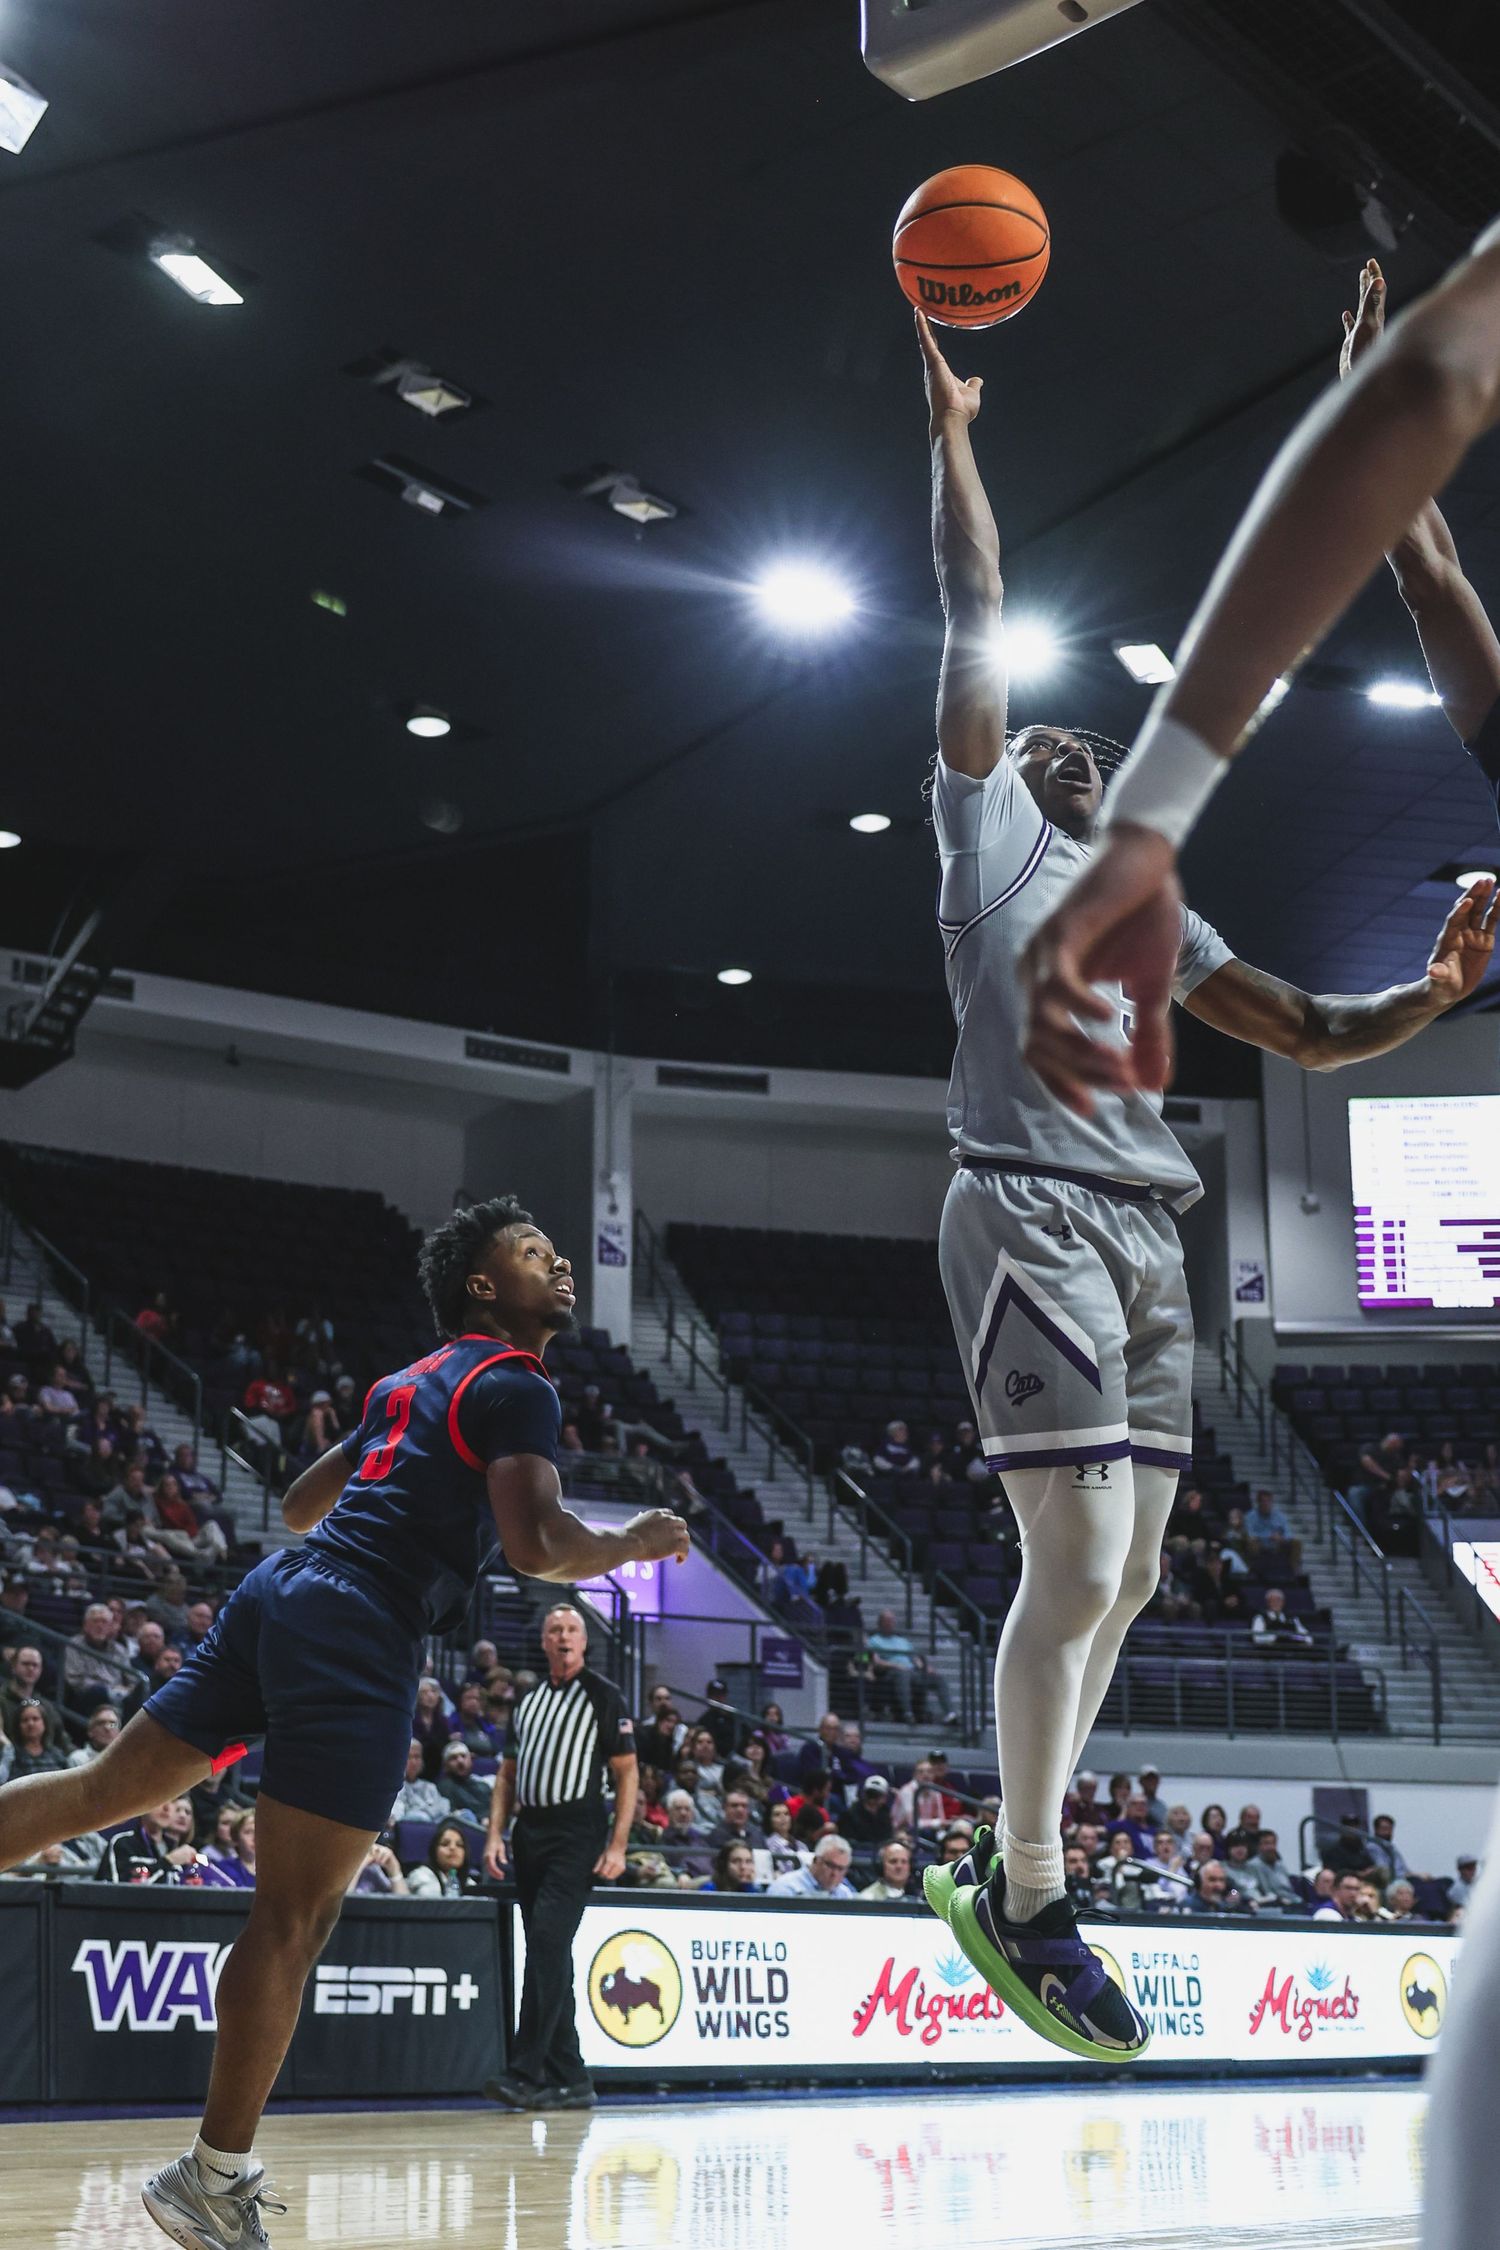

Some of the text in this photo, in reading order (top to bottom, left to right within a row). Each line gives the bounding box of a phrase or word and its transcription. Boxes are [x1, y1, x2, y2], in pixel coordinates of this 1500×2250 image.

[916, 275, 1022, 307] Wilson
[1005, 1370, 1045, 1404] Cats
[360, 1385, 417, 1480] 3
[691, 1940, 787, 1961] BUFFALO
[1131, 1952, 1199, 1971] BUFFALO
[71, 1939, 235, 2032] WA
[314, 1964, 480, 2016] ESPN+
[692, 1966, 789, 2005] WILD
[1133, 1975, 1202, 2008] WILD
[695, 2010, 790, 2038] WINGS
